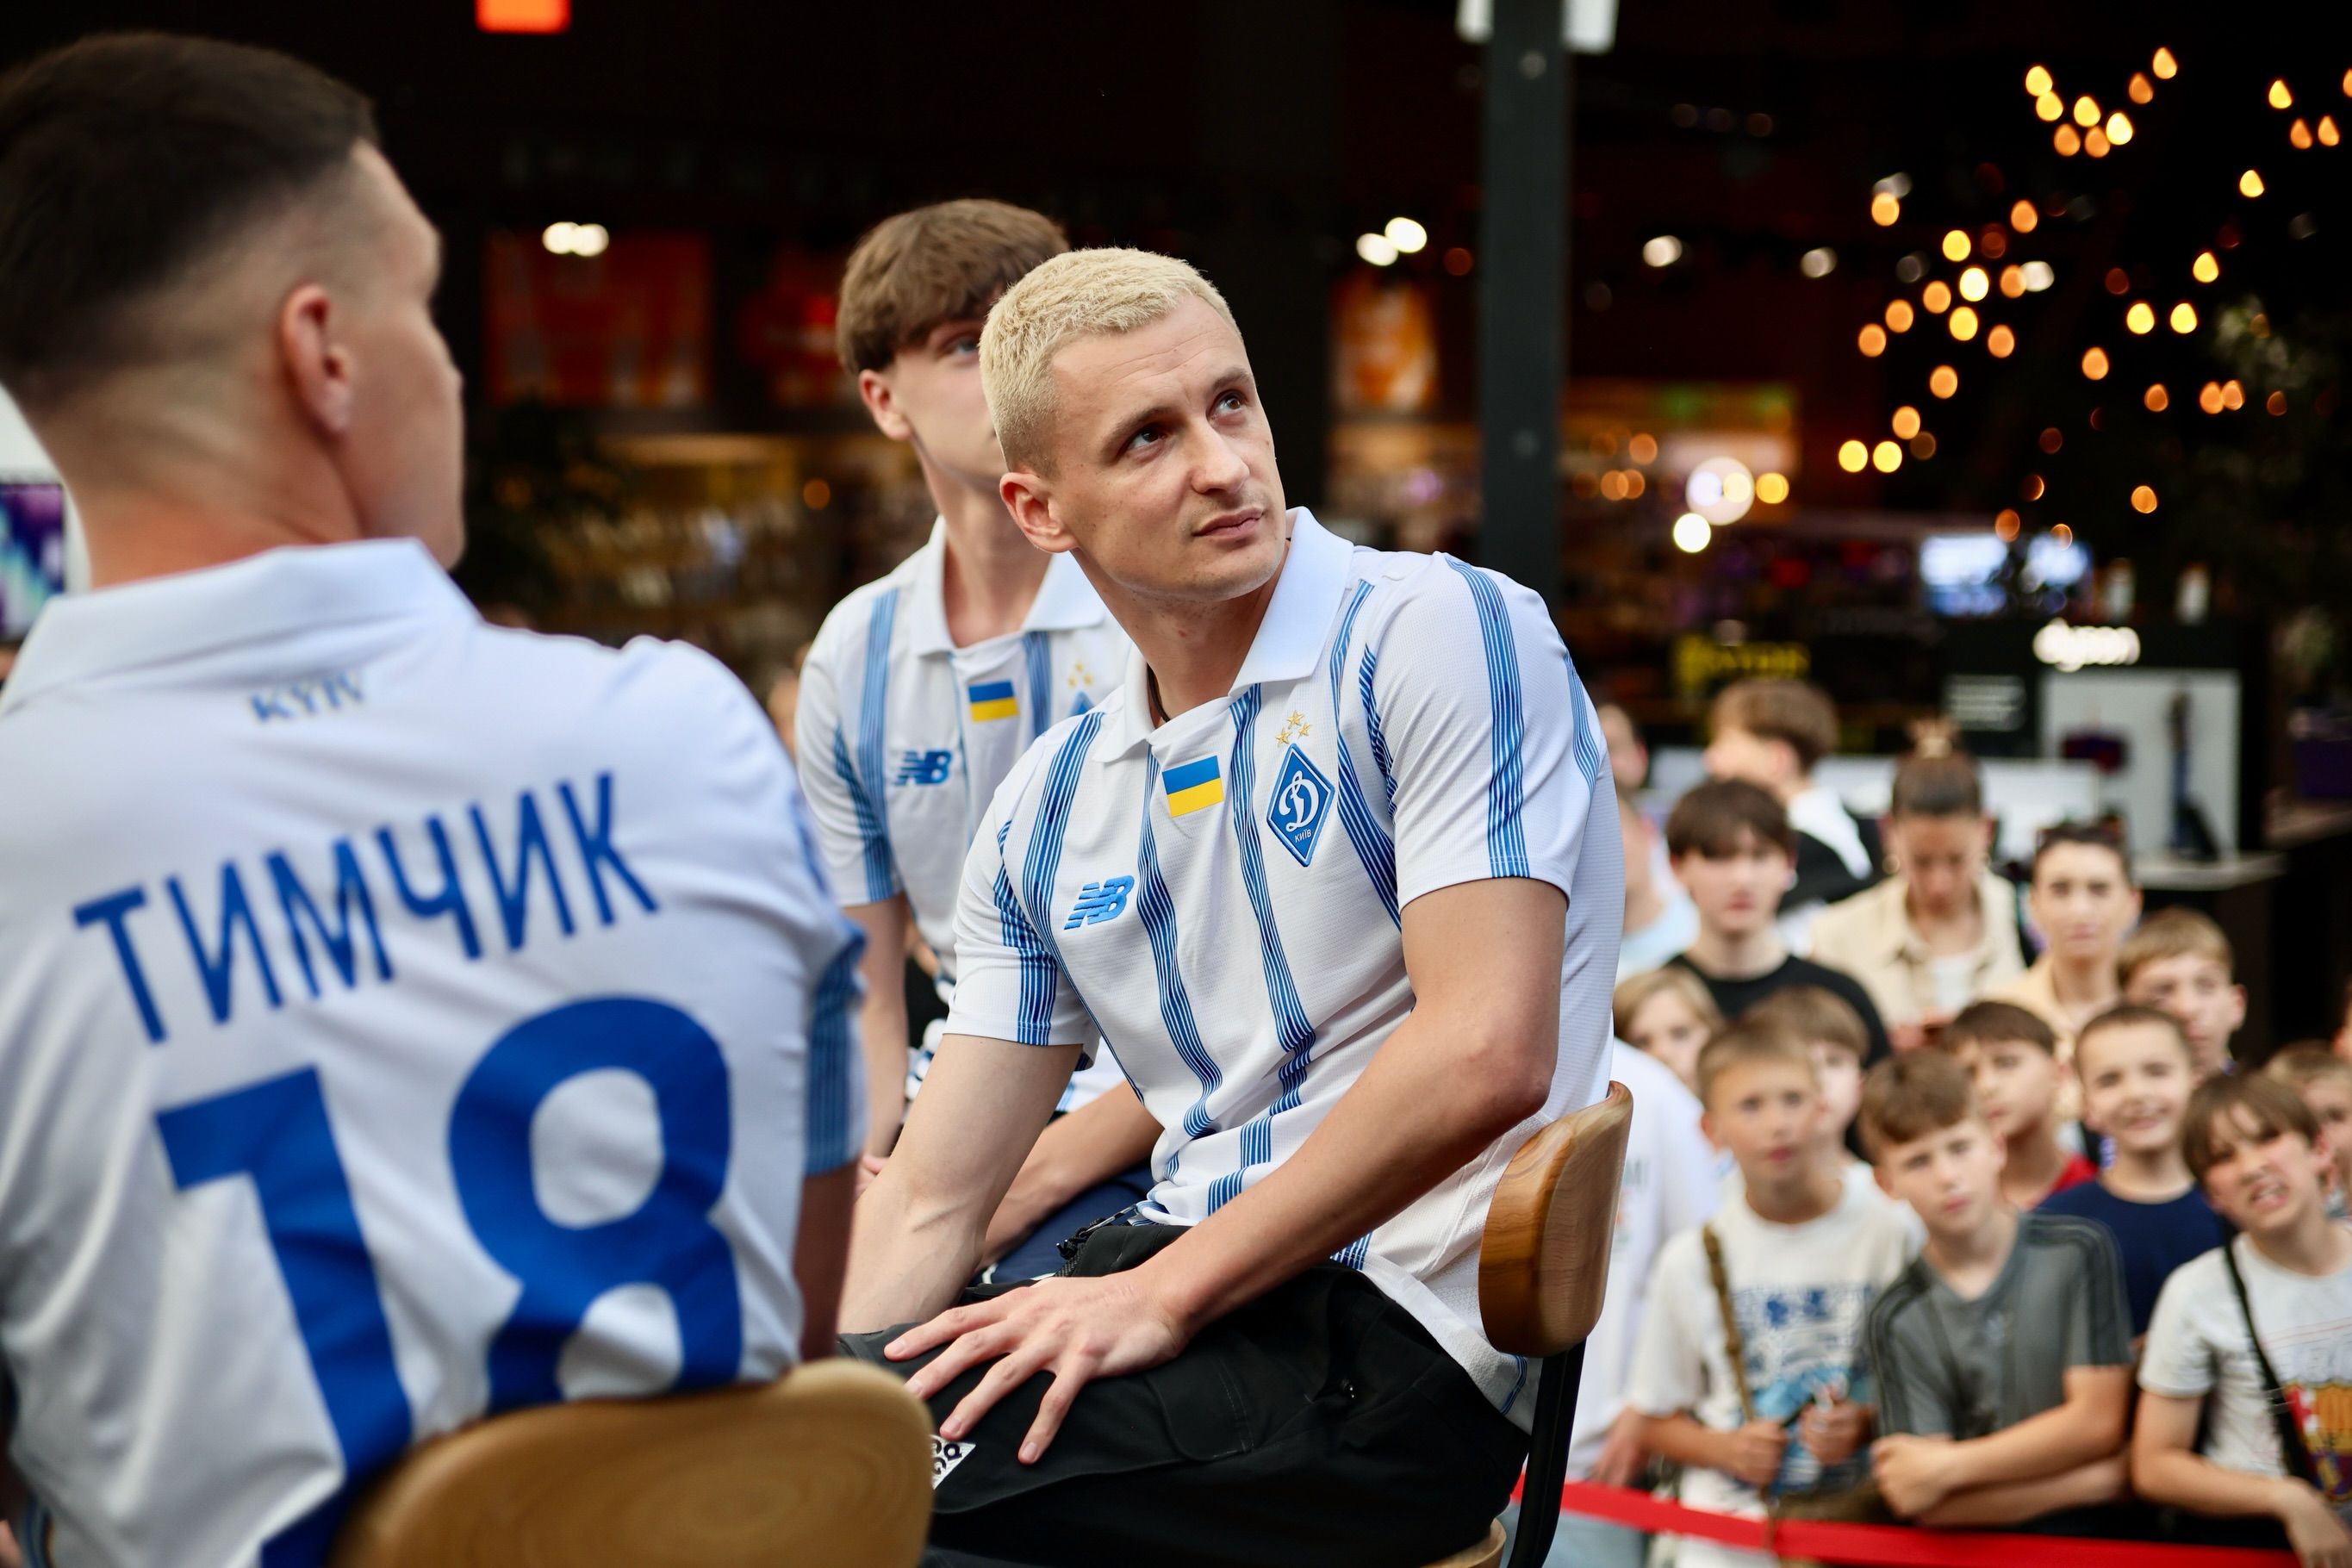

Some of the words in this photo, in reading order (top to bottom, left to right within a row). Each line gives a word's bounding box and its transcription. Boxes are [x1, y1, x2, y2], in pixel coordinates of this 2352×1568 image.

[73, 771, 659, 1043] ТИМЧИК
[1294, 828, 1312, 843] КИЇВ
[156, 995, 743, 1568] 18
